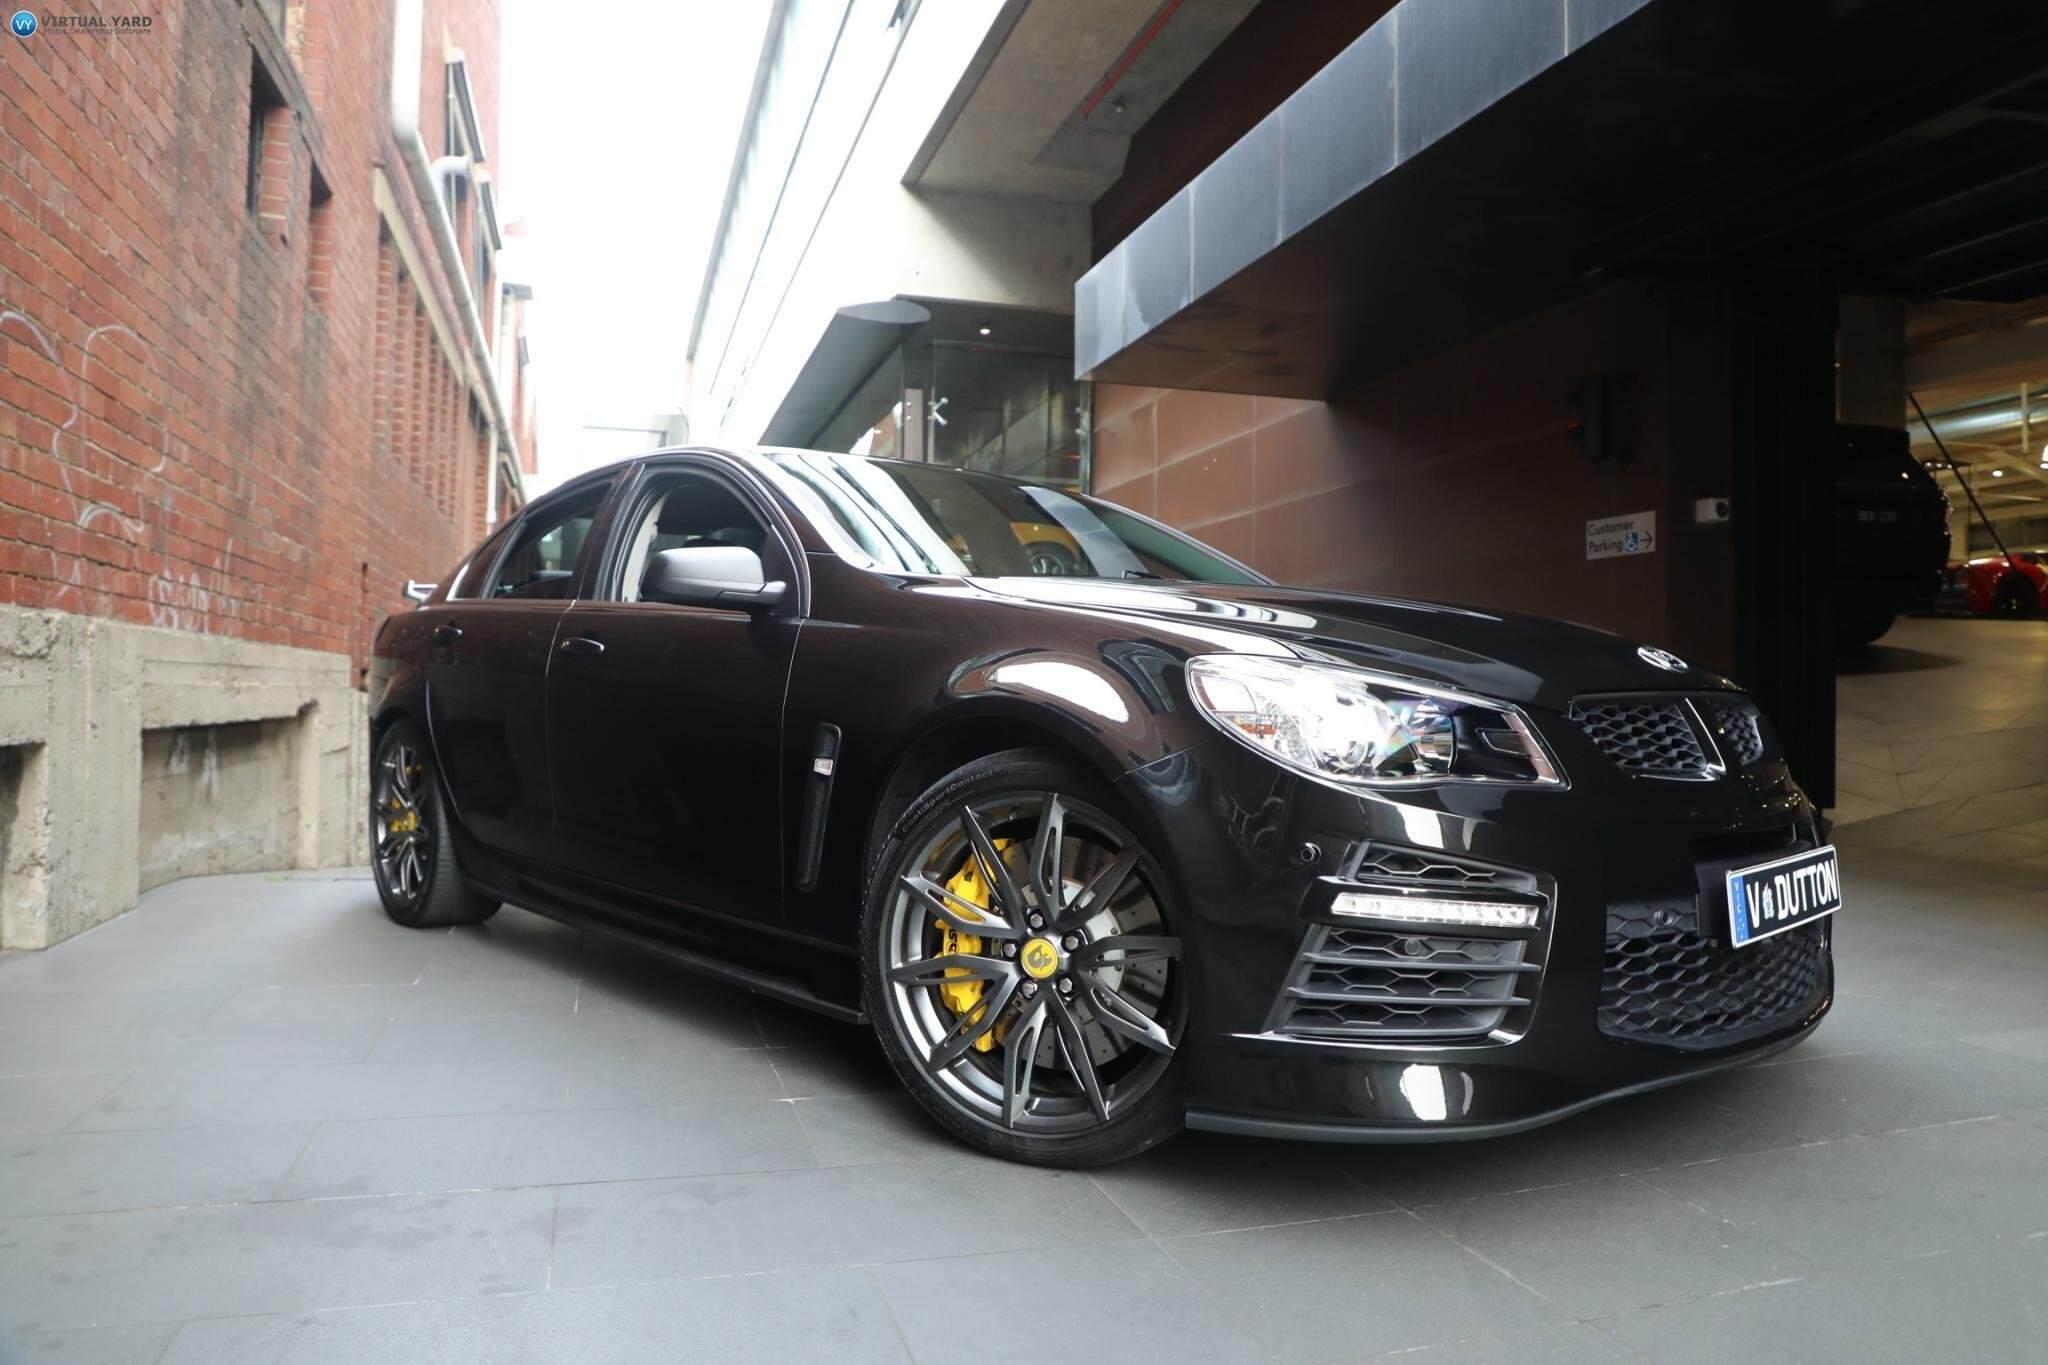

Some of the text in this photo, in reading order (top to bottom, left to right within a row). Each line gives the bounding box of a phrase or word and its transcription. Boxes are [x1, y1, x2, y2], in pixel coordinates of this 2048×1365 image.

[1588, 521, 1634, 536] Customer
[1588, 539, 1623, 553] Parking
[1746, 858, 1839, 929] V DUTTON
